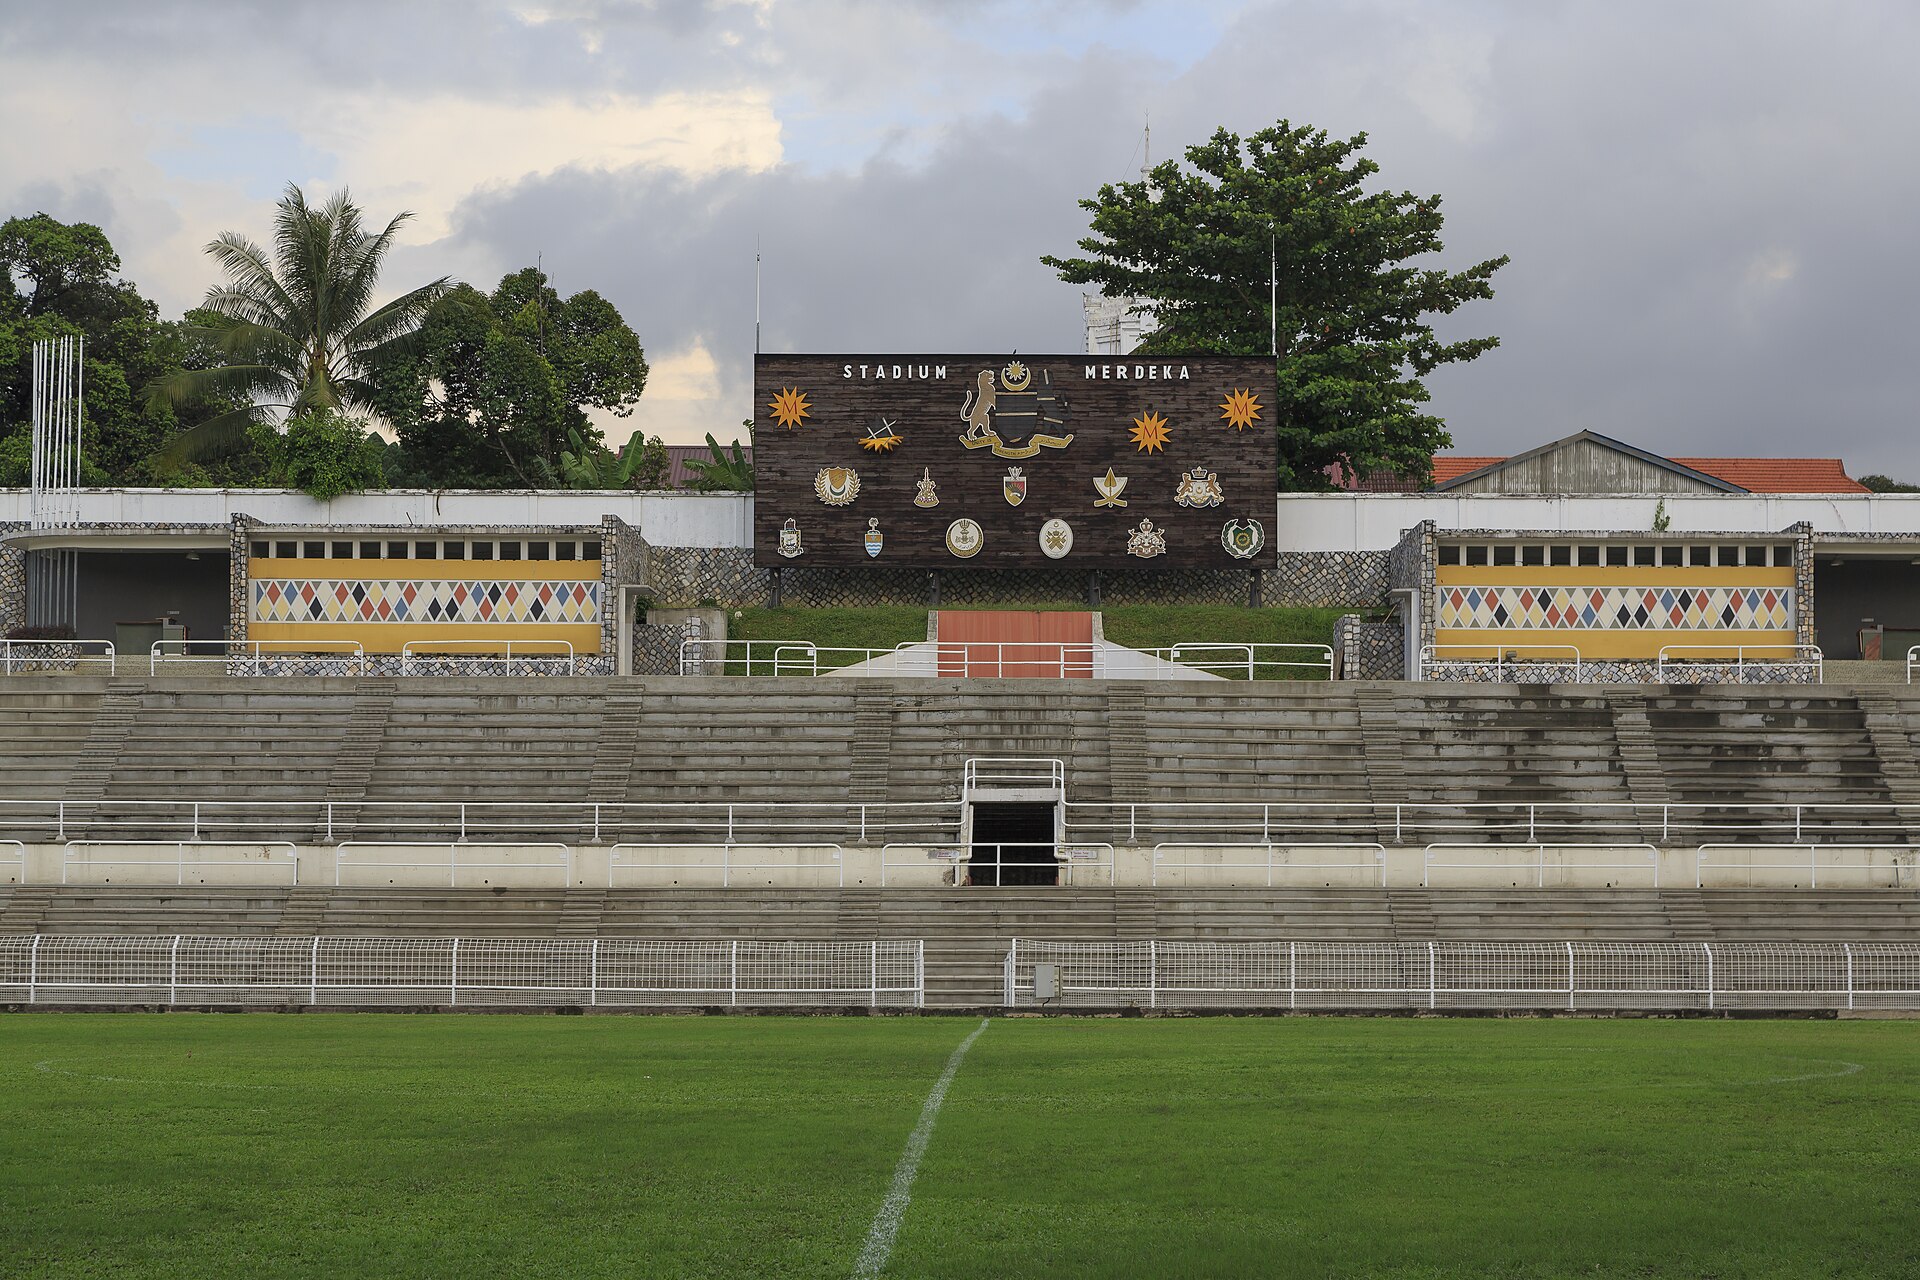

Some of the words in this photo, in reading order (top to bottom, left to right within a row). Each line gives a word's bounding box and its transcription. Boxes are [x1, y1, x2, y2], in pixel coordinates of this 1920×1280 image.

[843, 364, 946, 379] STADIUM
[1085, 365, 1190, 380] MERDEKA
[782, 400, 798, 415] M
[1233, 402, 1249, 416] M
[1143, 425, 1158, 440] M
